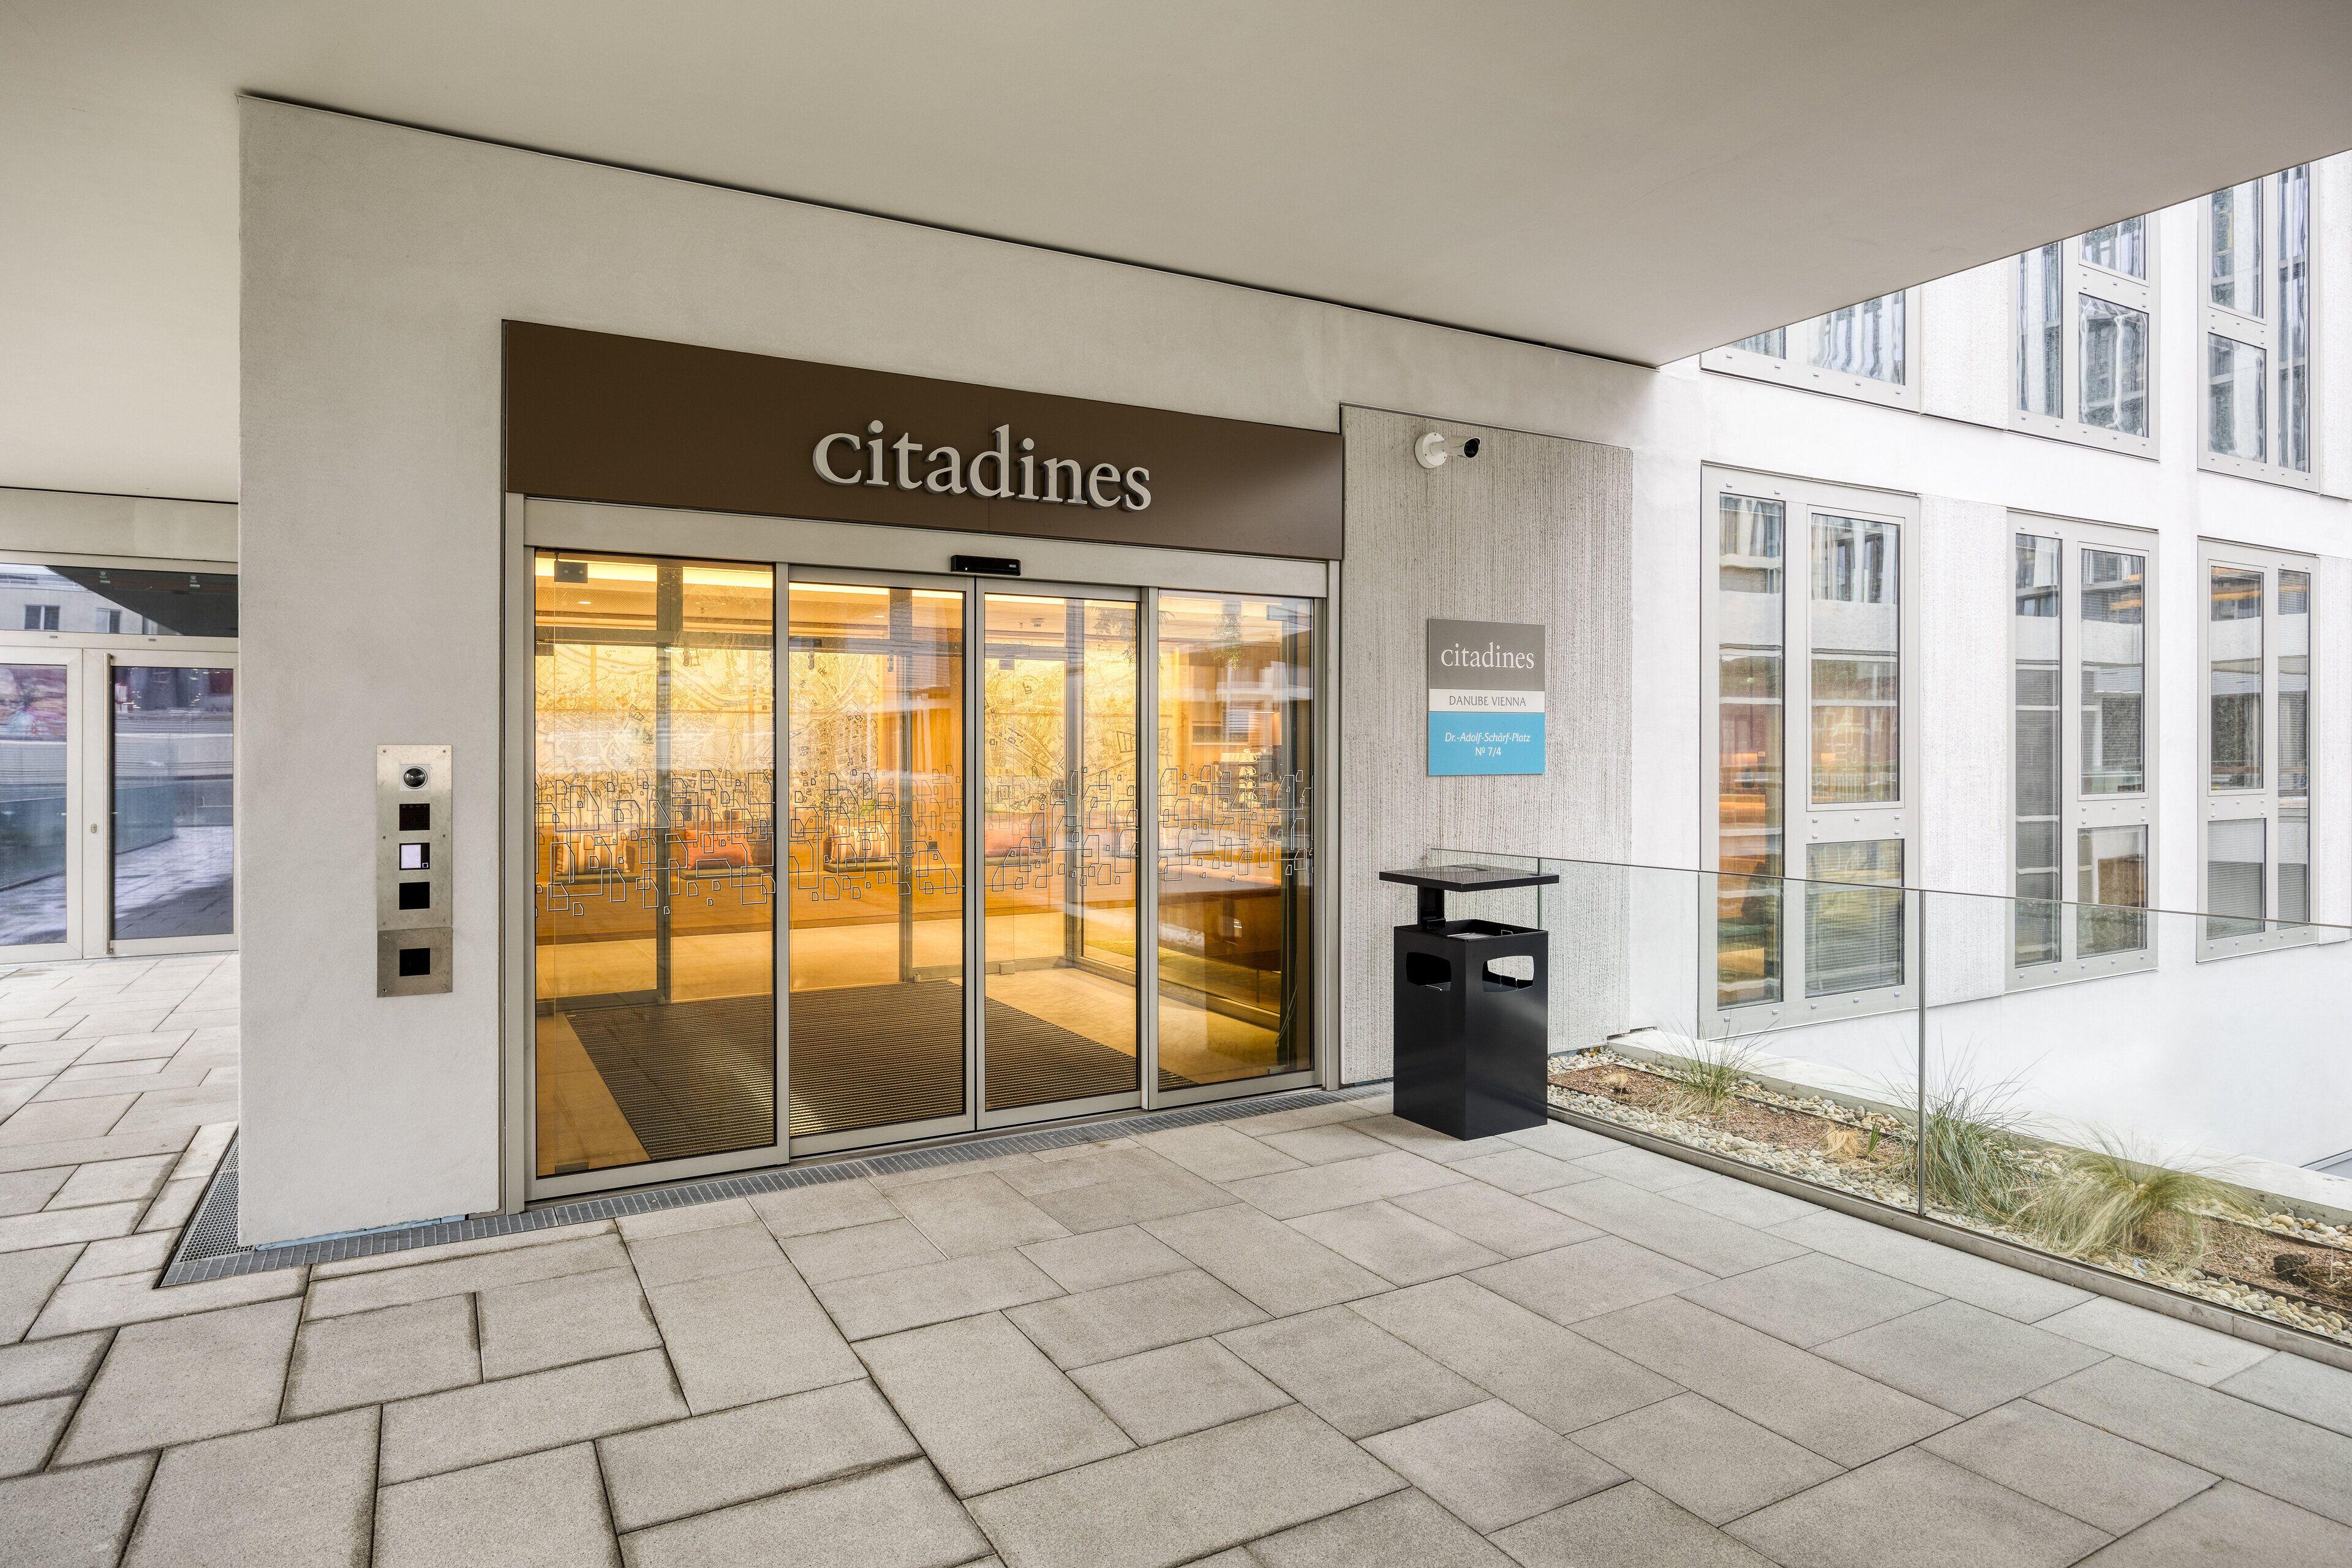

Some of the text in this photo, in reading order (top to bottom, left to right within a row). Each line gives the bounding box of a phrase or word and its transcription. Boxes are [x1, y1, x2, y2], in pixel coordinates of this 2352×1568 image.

[813, 420, 1152, 511] citadines
[1441, 641, 1535, 669] citadines
[1449, 696, 1526, 706] DANUBE VIENNA
[1444, 732, 1531, 744] Dr.-Adolf-Schärf-Platz
[1488, 747, 1501, 757] 7/4
